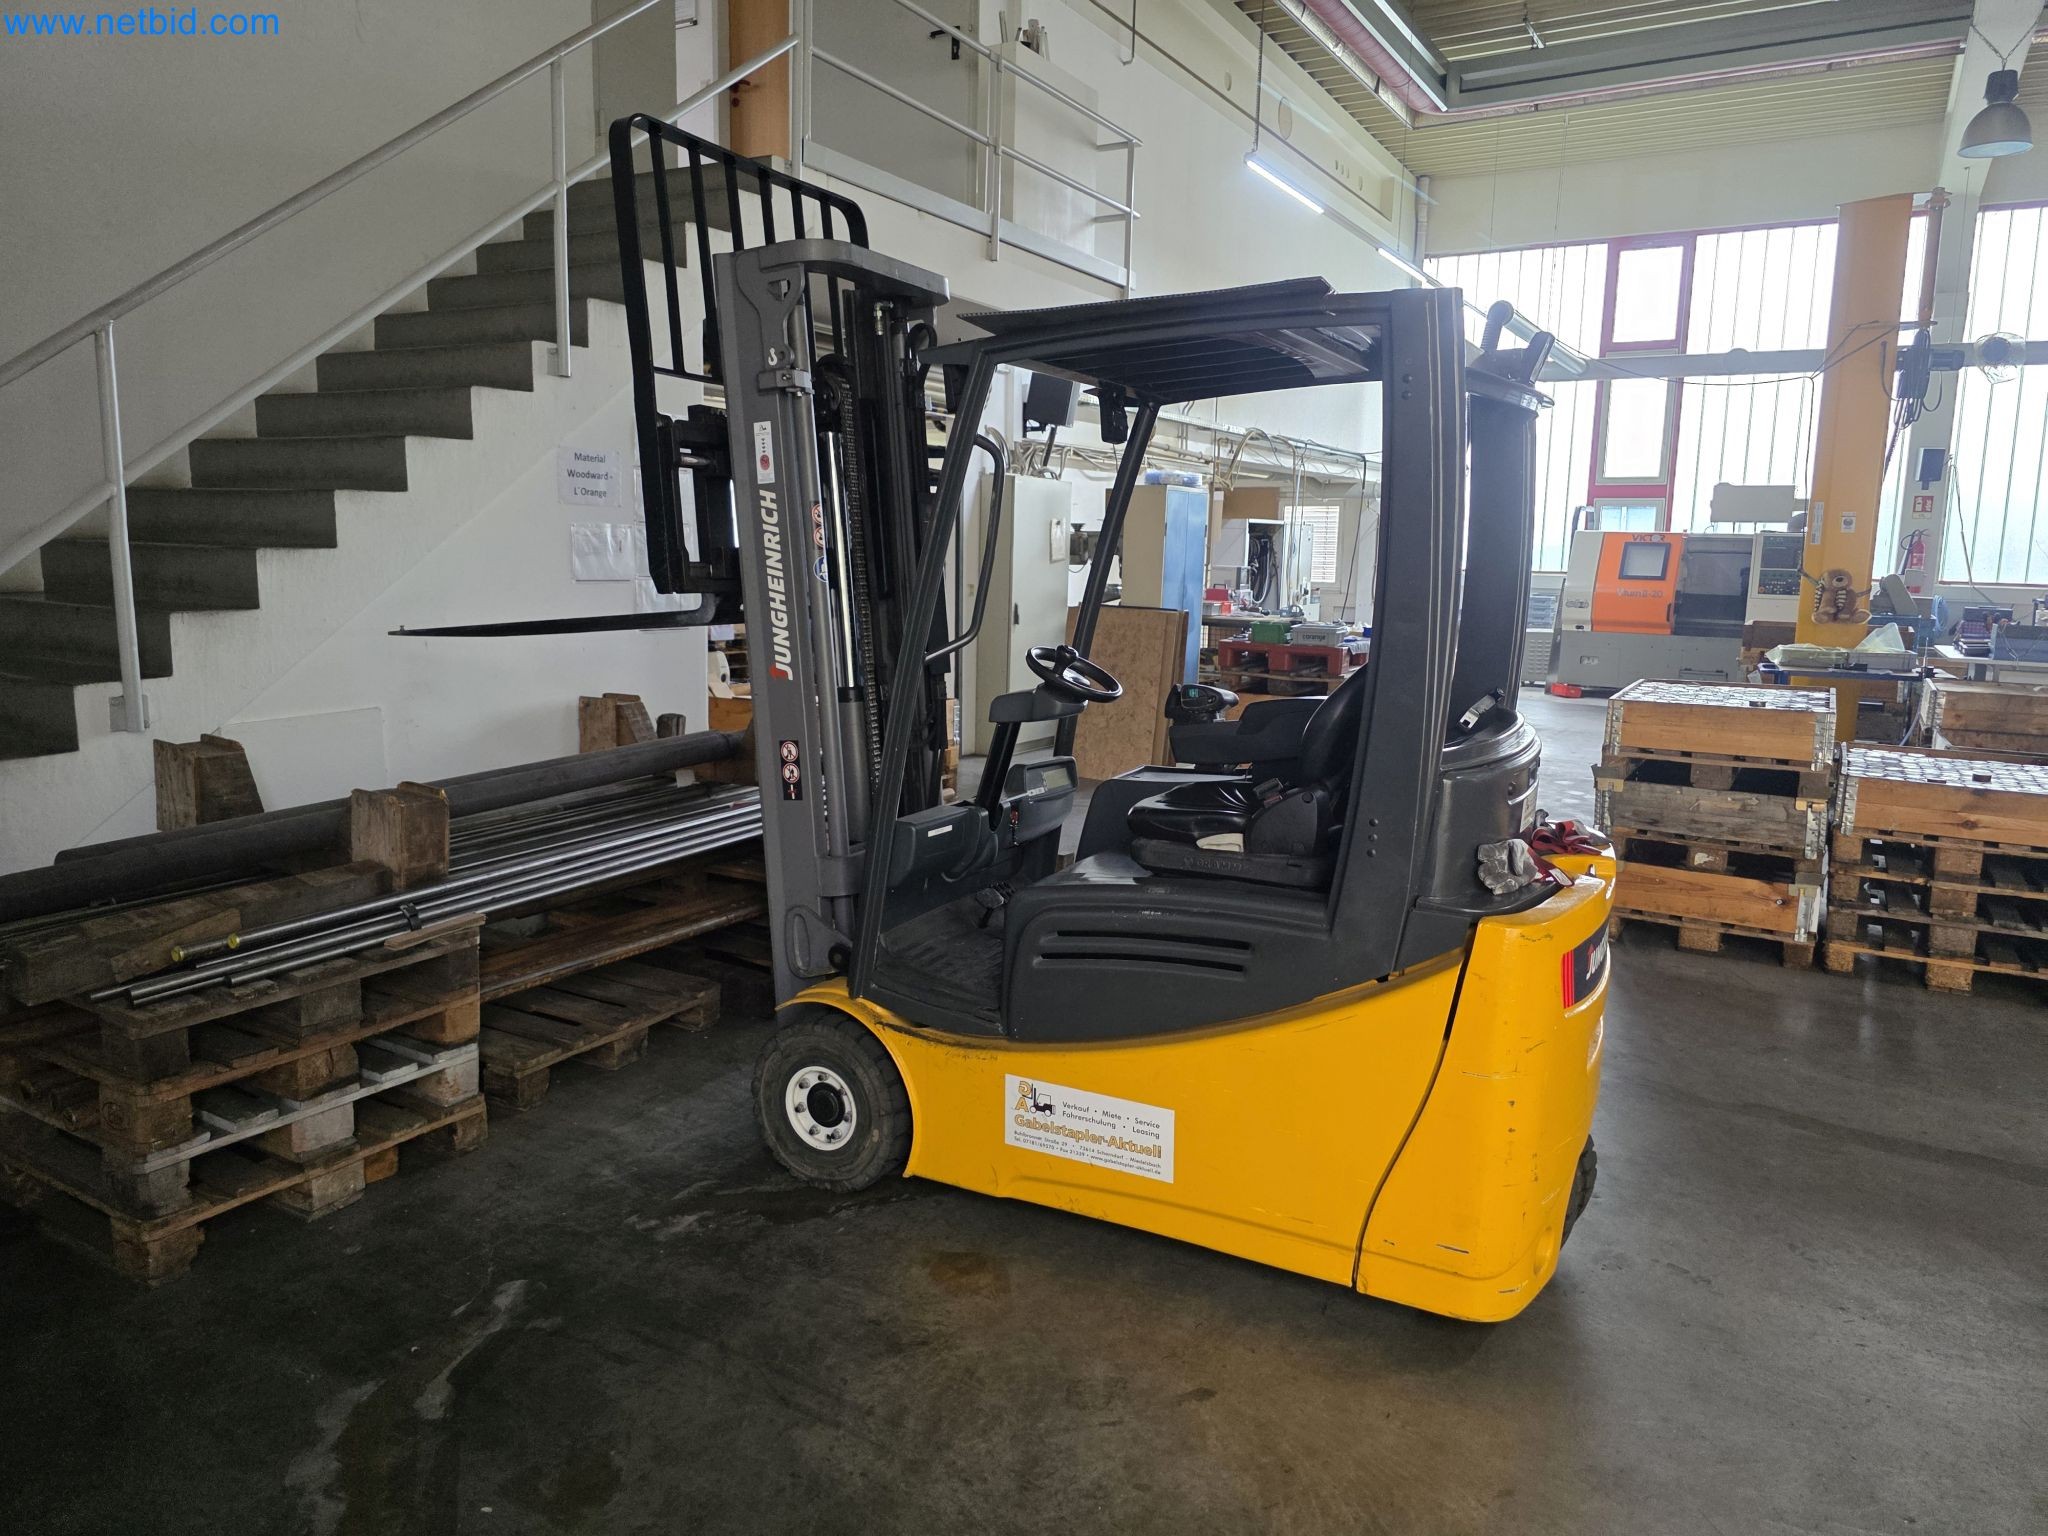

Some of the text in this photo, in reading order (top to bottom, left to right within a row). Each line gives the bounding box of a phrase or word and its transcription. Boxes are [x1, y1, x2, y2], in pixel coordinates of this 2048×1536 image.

[574, 452, 606, 463] Material
[567, 469, 609, 481] Woodward
[759, 489, 794, 681] JUNGHEINRICH
[1062, 1101, 1160, 1129] Verkauf Miete Service
[1062, 1111, 1160, 1140] Fahrerschulung Leasing
[1014, 1114, 1162, 1159] Gabelstapler-Aktuell
